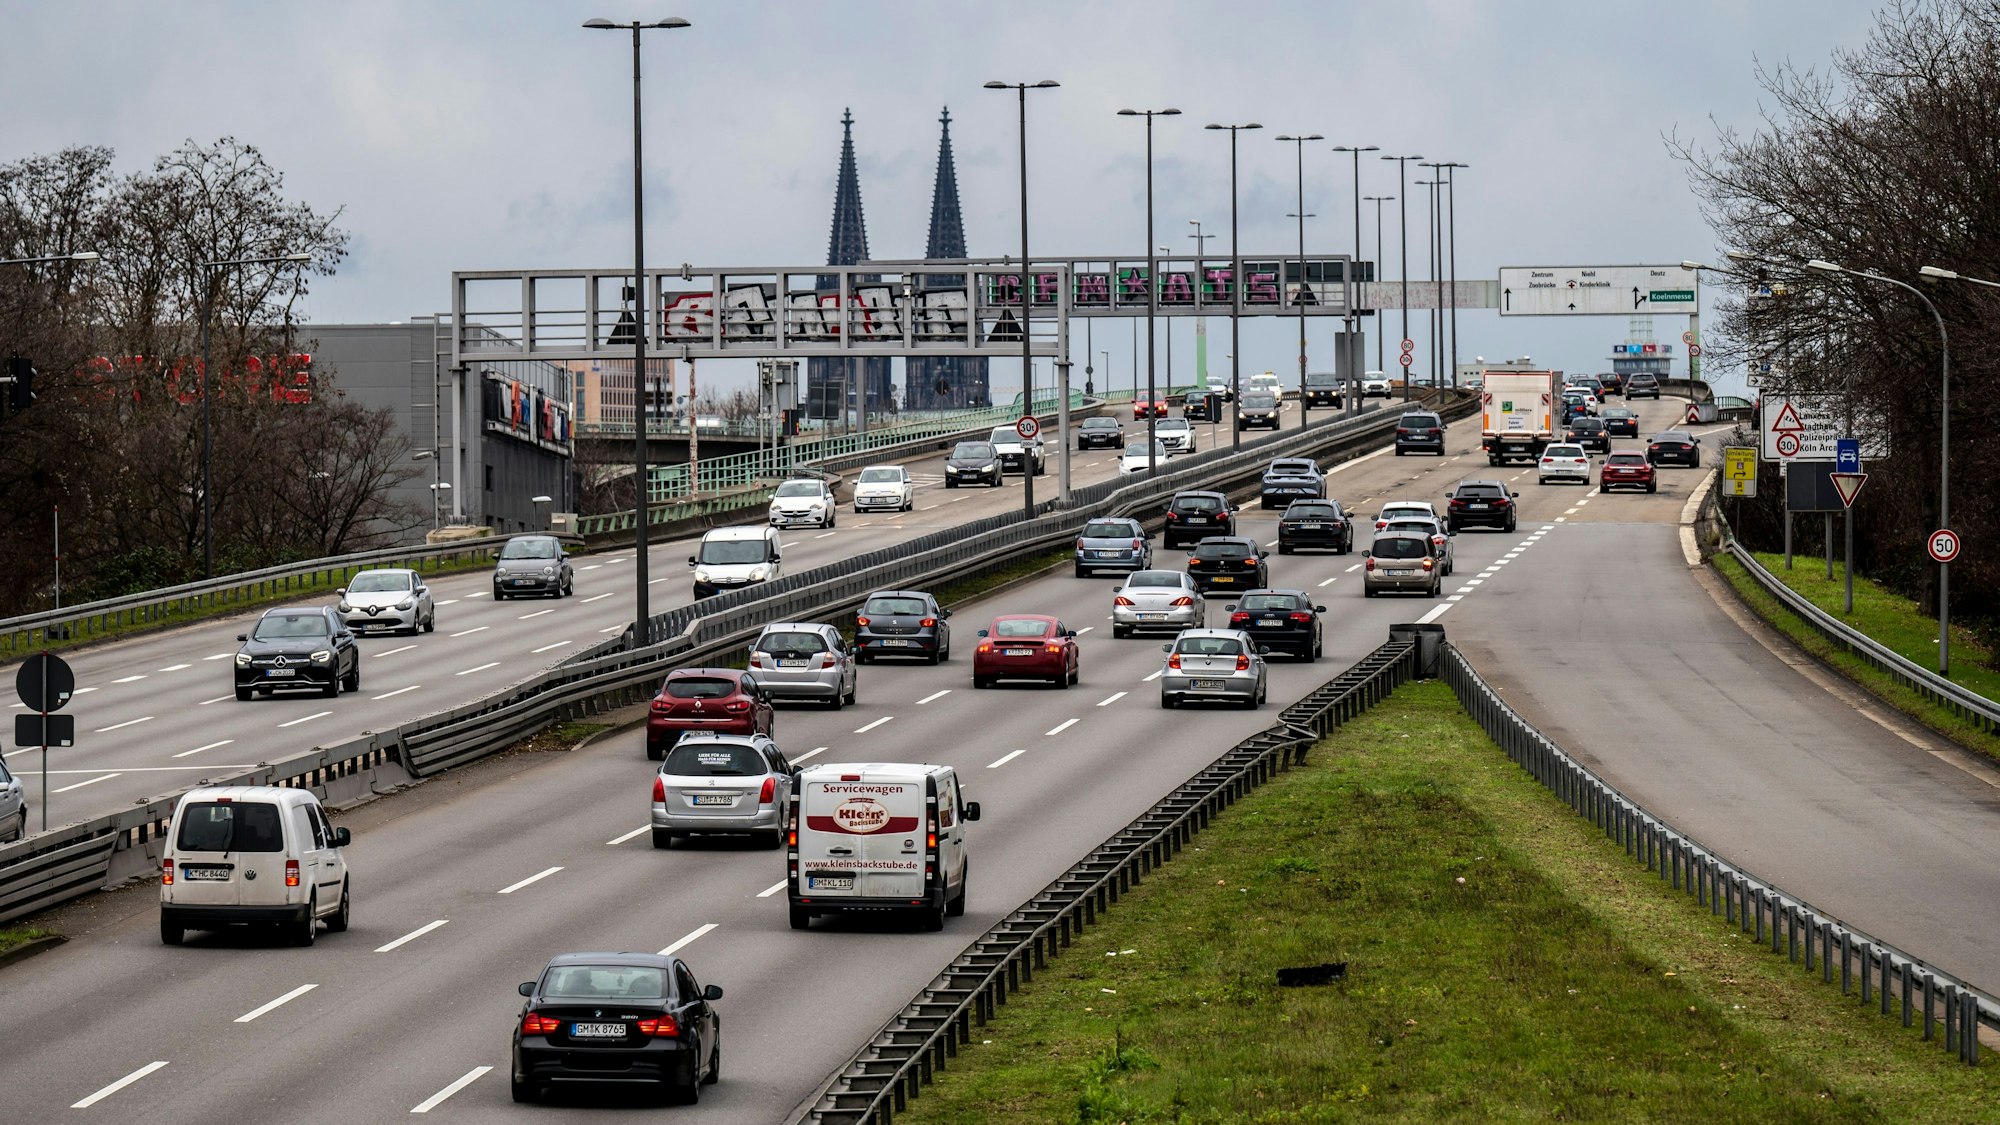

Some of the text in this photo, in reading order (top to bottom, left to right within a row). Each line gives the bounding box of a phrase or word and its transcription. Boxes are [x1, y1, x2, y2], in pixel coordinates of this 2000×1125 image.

[1020, 422, 1034, 432] 30t
[1780, 440, 1796, 450] 30t
[1936, 538, 1953, 552] 50
[823, 784, 903, 796] Servicewagen
[804, 860, 918, 870] www.kleinsbackstube.de
[814, 878, 852, 886] BM KL 110
[578, 1024, 624, 1034] GM K 8765
